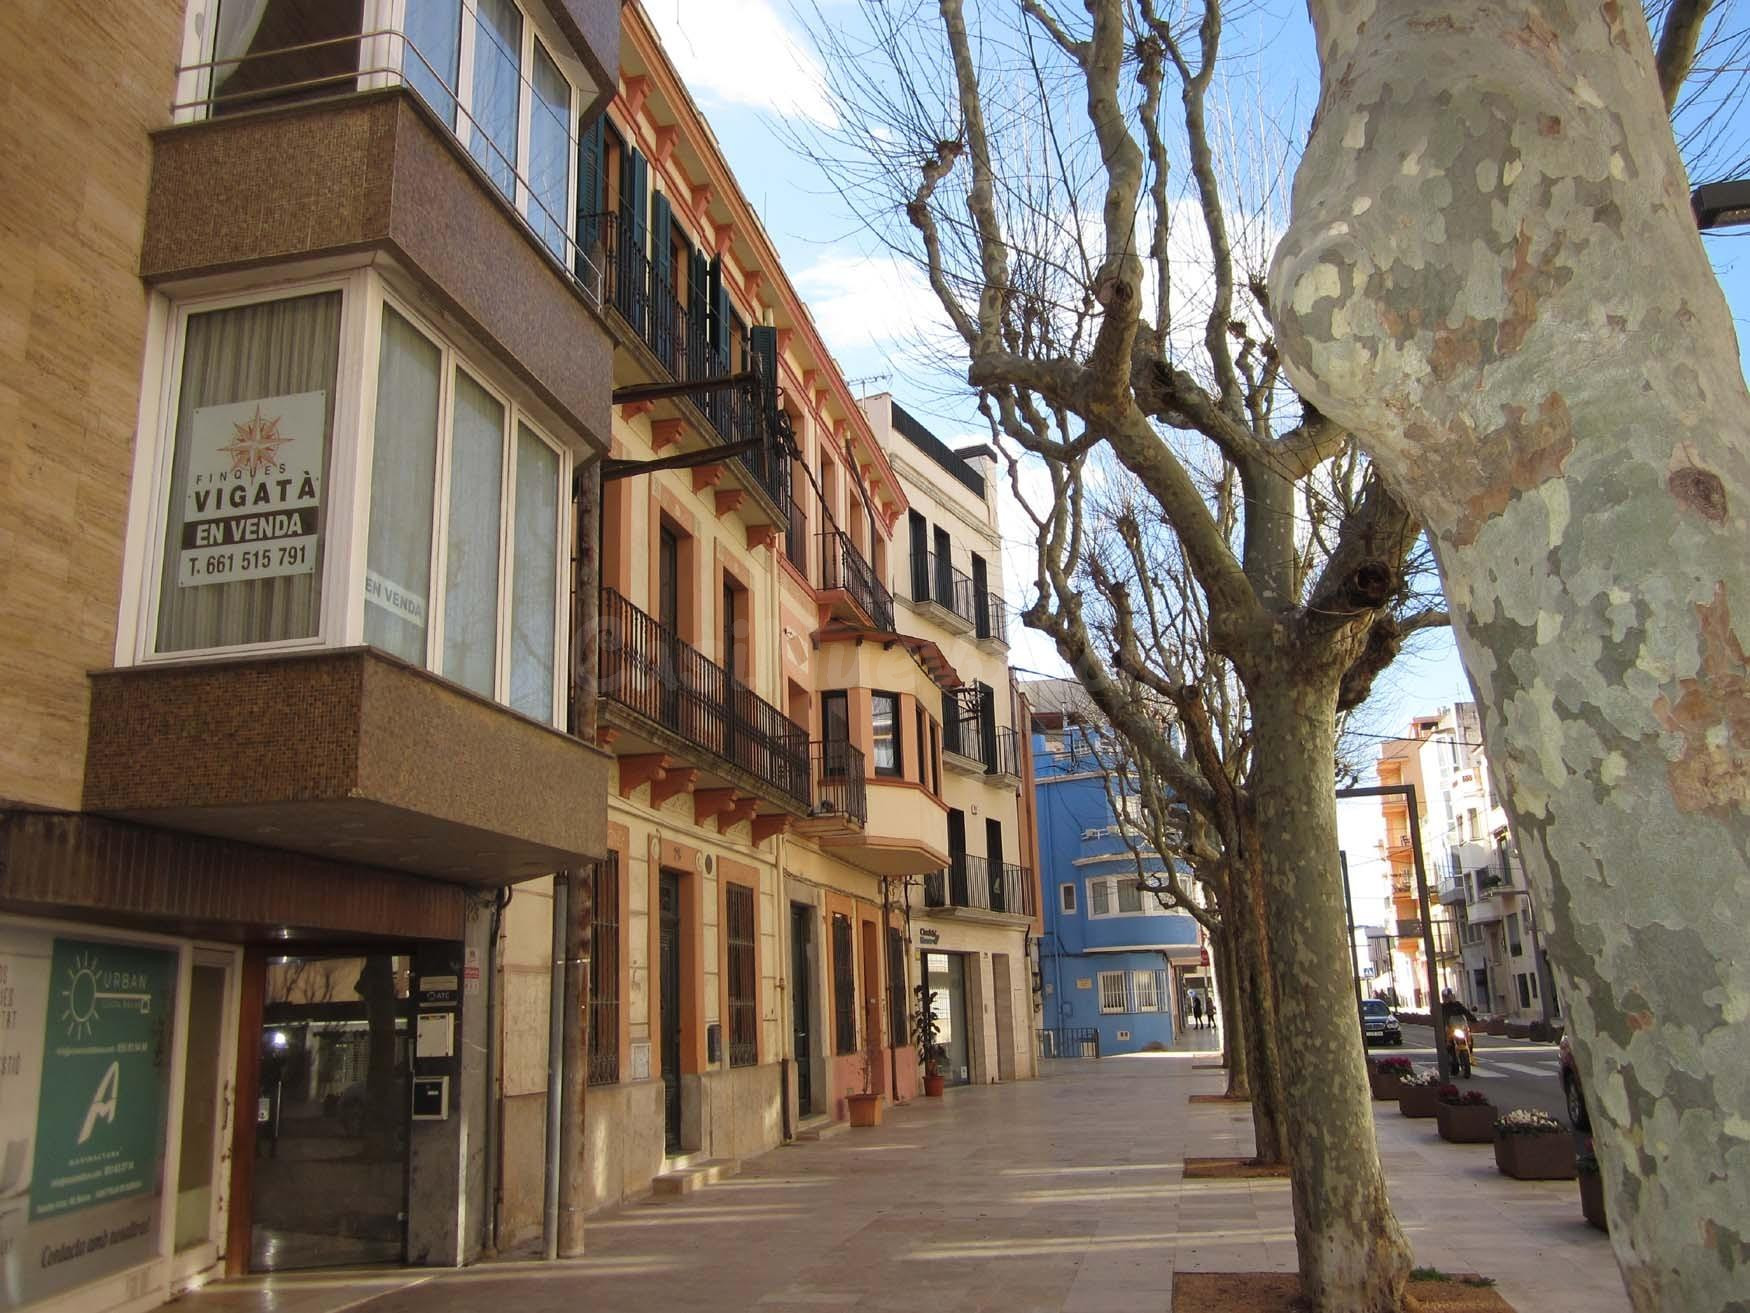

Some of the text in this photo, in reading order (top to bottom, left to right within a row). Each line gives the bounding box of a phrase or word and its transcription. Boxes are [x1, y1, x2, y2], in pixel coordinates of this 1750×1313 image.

[196, 464, 286, 485] FINQUES
[194, 471, 316, 513] VIGATÀ
[196, 513, 303, 546] EN VENDA
[189, 545, 306, 576] T. 661 515 791
[365, 577, 422, 616] EN VENDA
[103, 970, 148, 989] URBAN
